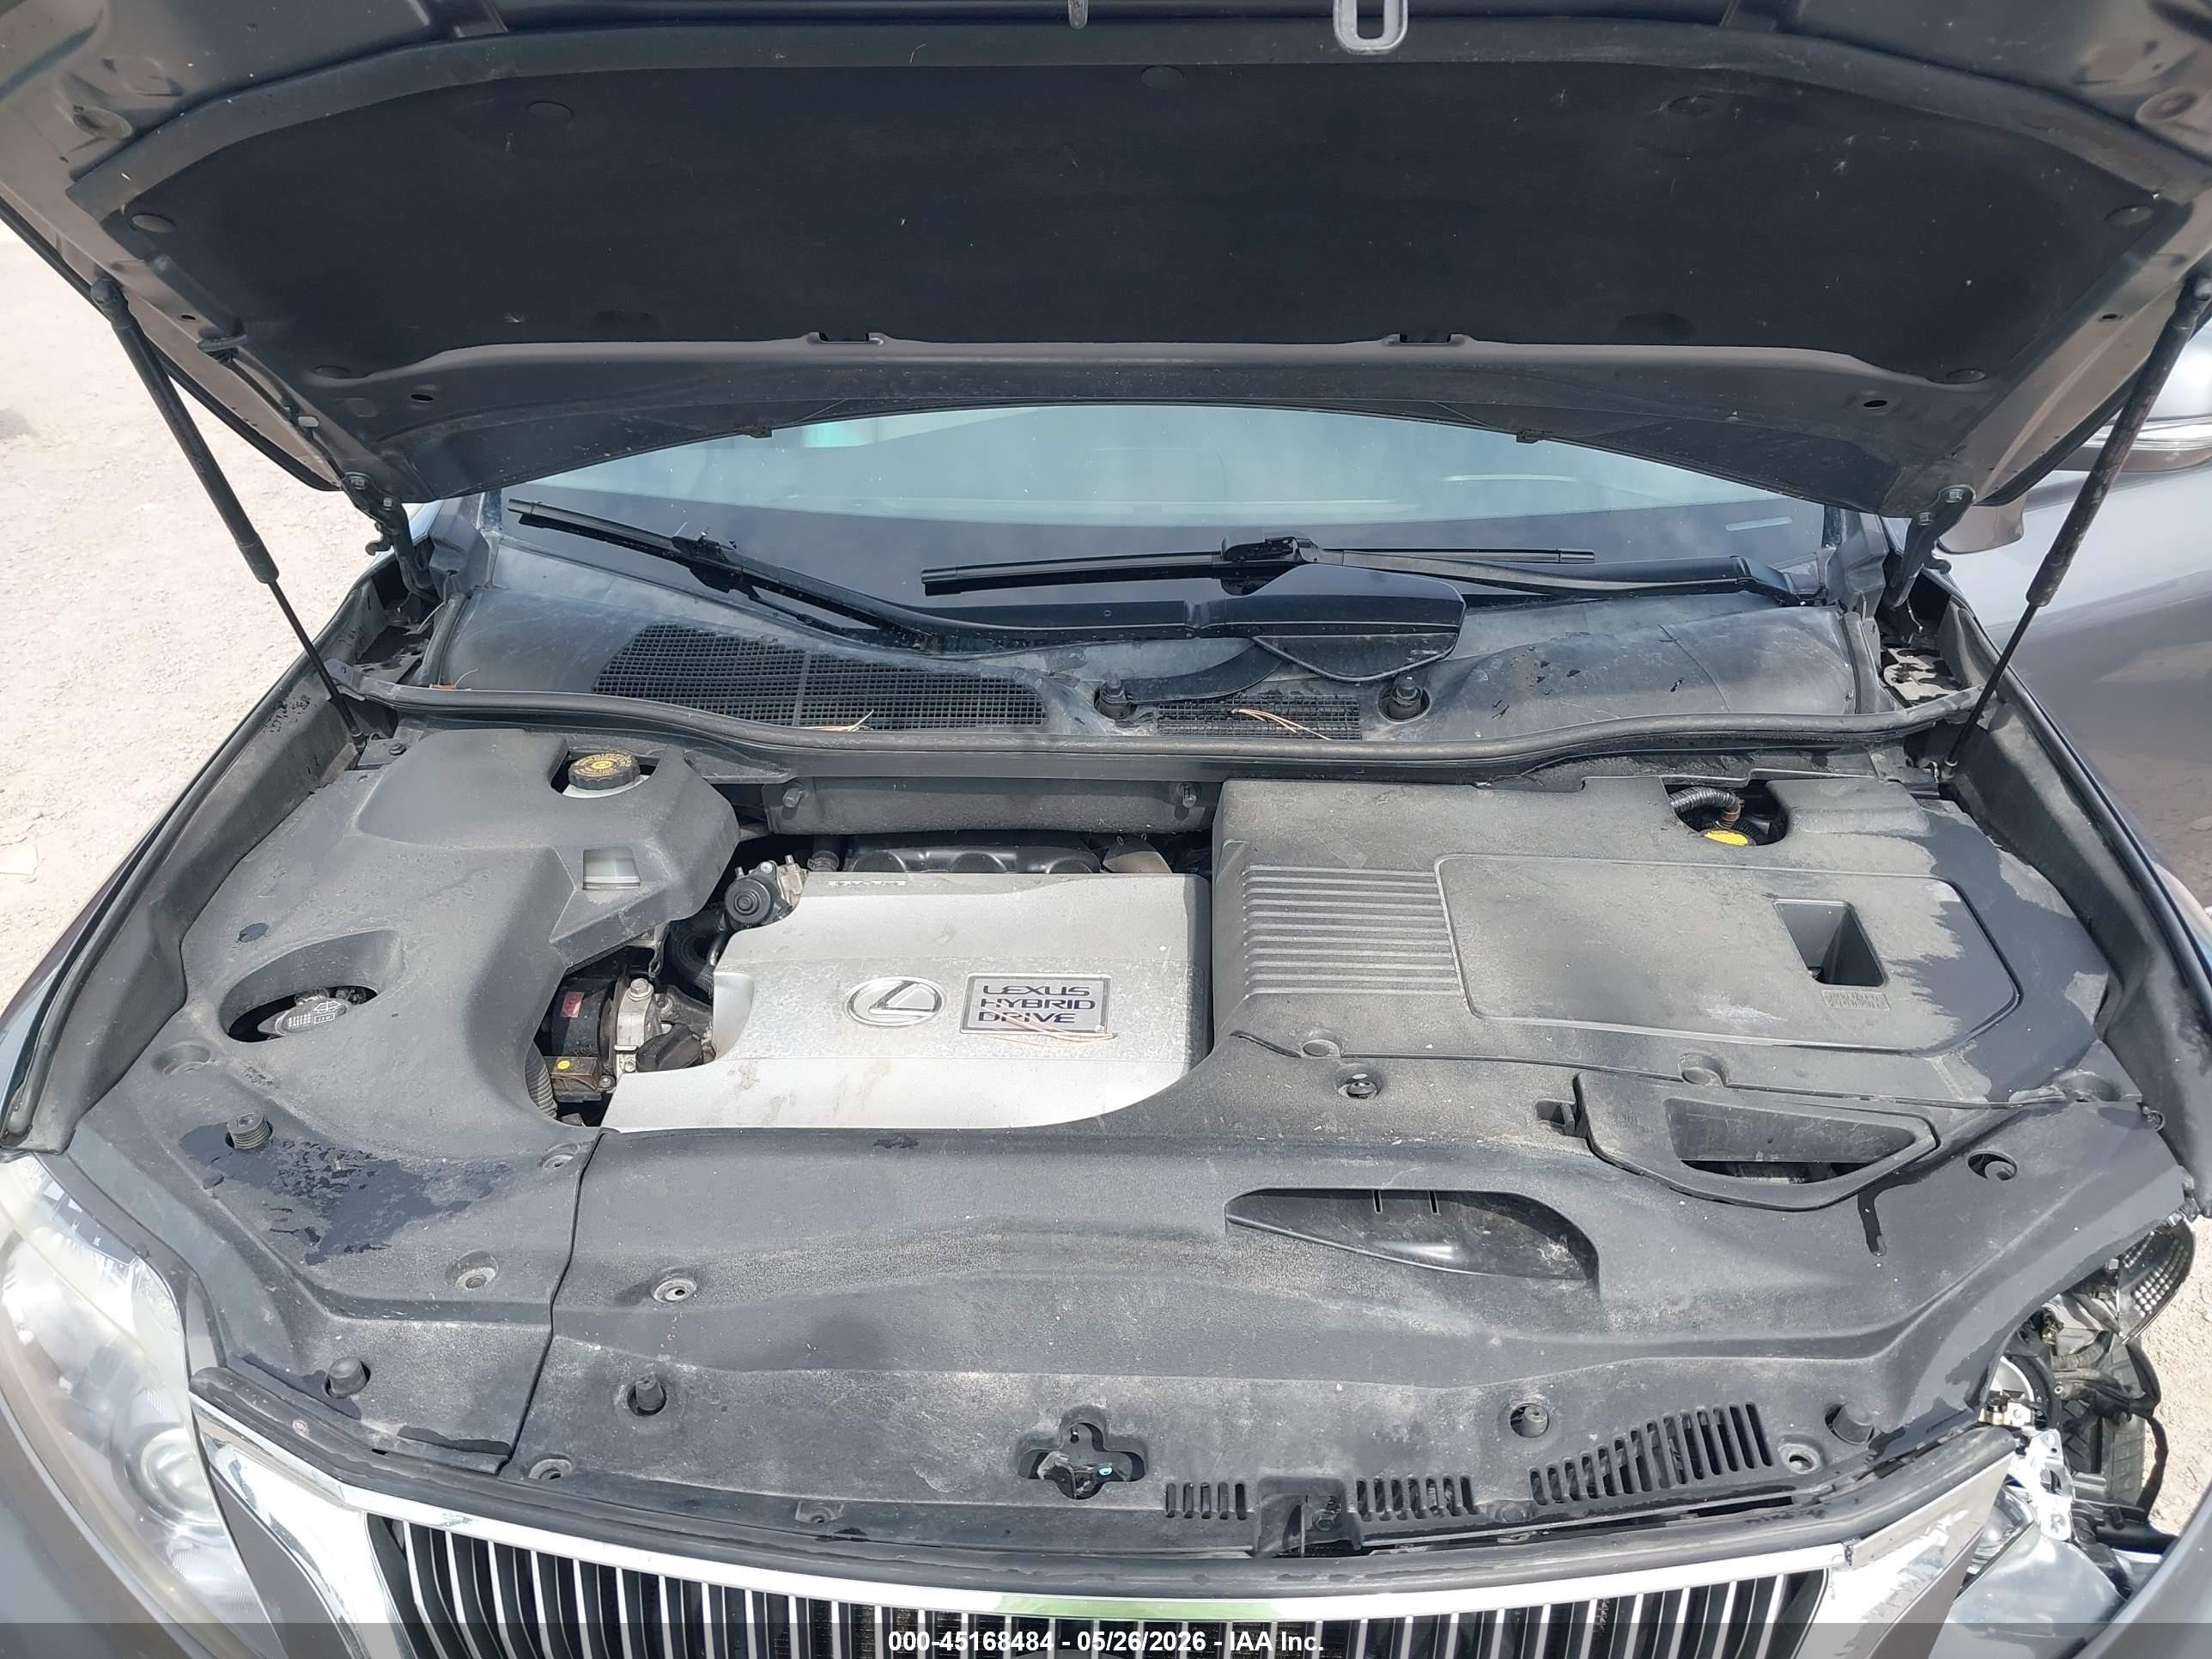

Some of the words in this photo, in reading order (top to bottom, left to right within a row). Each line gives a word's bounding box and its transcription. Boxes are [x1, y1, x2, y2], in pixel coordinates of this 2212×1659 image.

[982, 985, 1091, 996] LEXUS
[980, 998, 1097, 1010] HYBRID
[978, 1011, 1077, 1024] DRIVE
